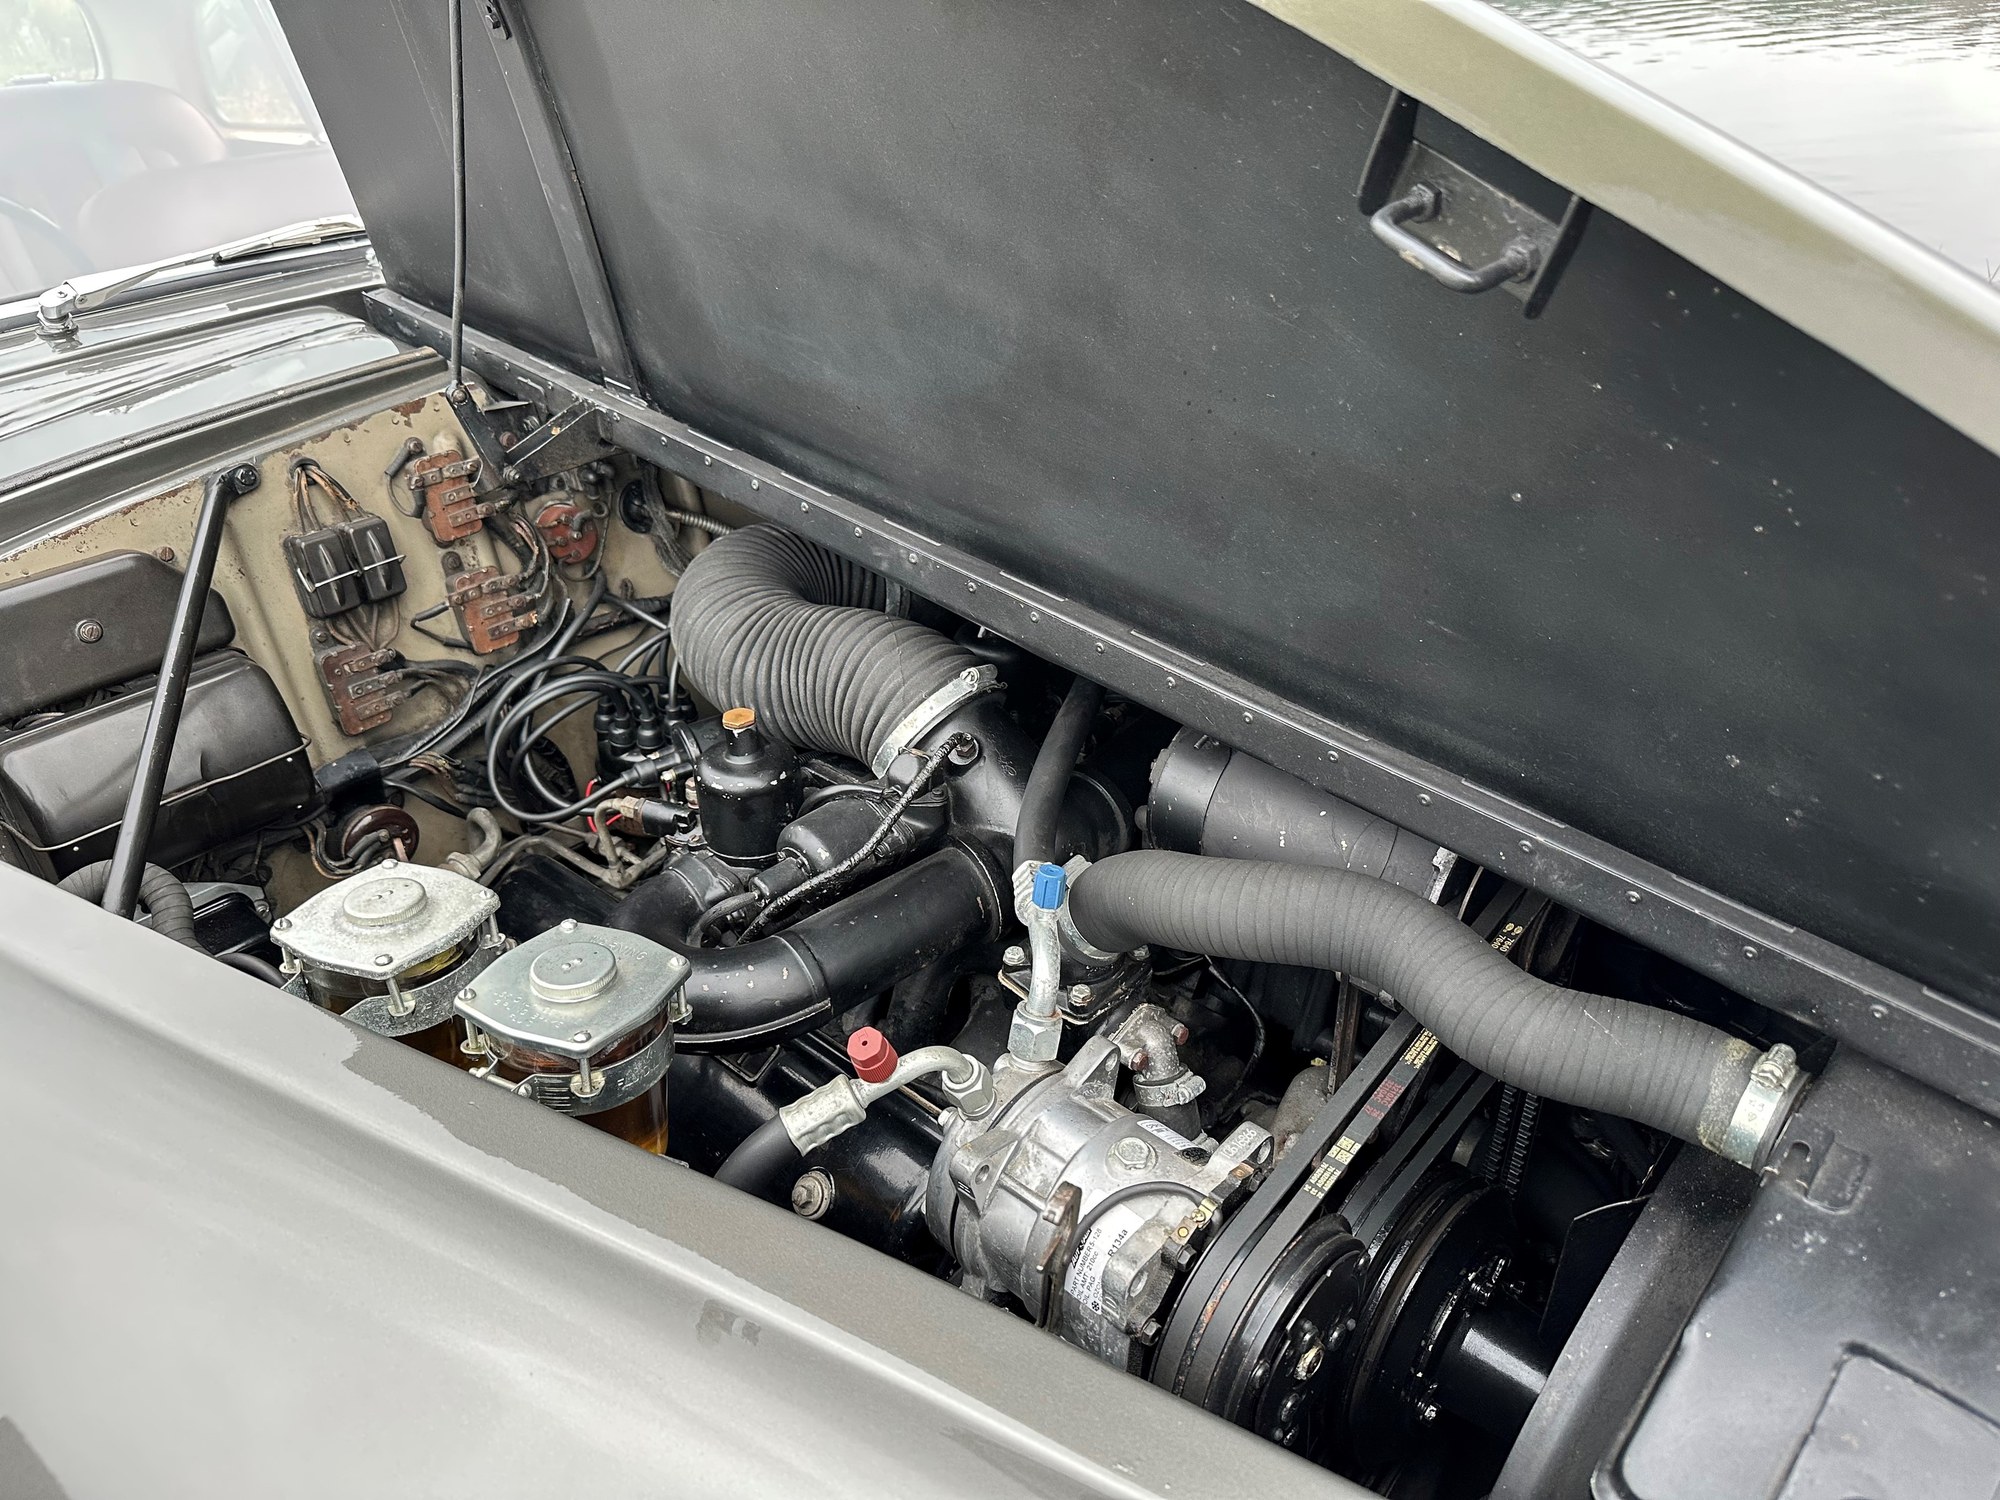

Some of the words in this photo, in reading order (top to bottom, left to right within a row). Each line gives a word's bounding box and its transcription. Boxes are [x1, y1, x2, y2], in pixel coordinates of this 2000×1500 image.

[1491, 934, 1506, 949] 7640
[1499, 937, 1514, 952] 7640
[1107, 1229, 1128, 1257] R134a
[1080, 1272, 1089, 1288] AMT
[1087, 1251, 1098, 1271] 210cc
[1070, 1277, 1079, 1295] PART
[1085, 1275, 1095, 1291] PAG
